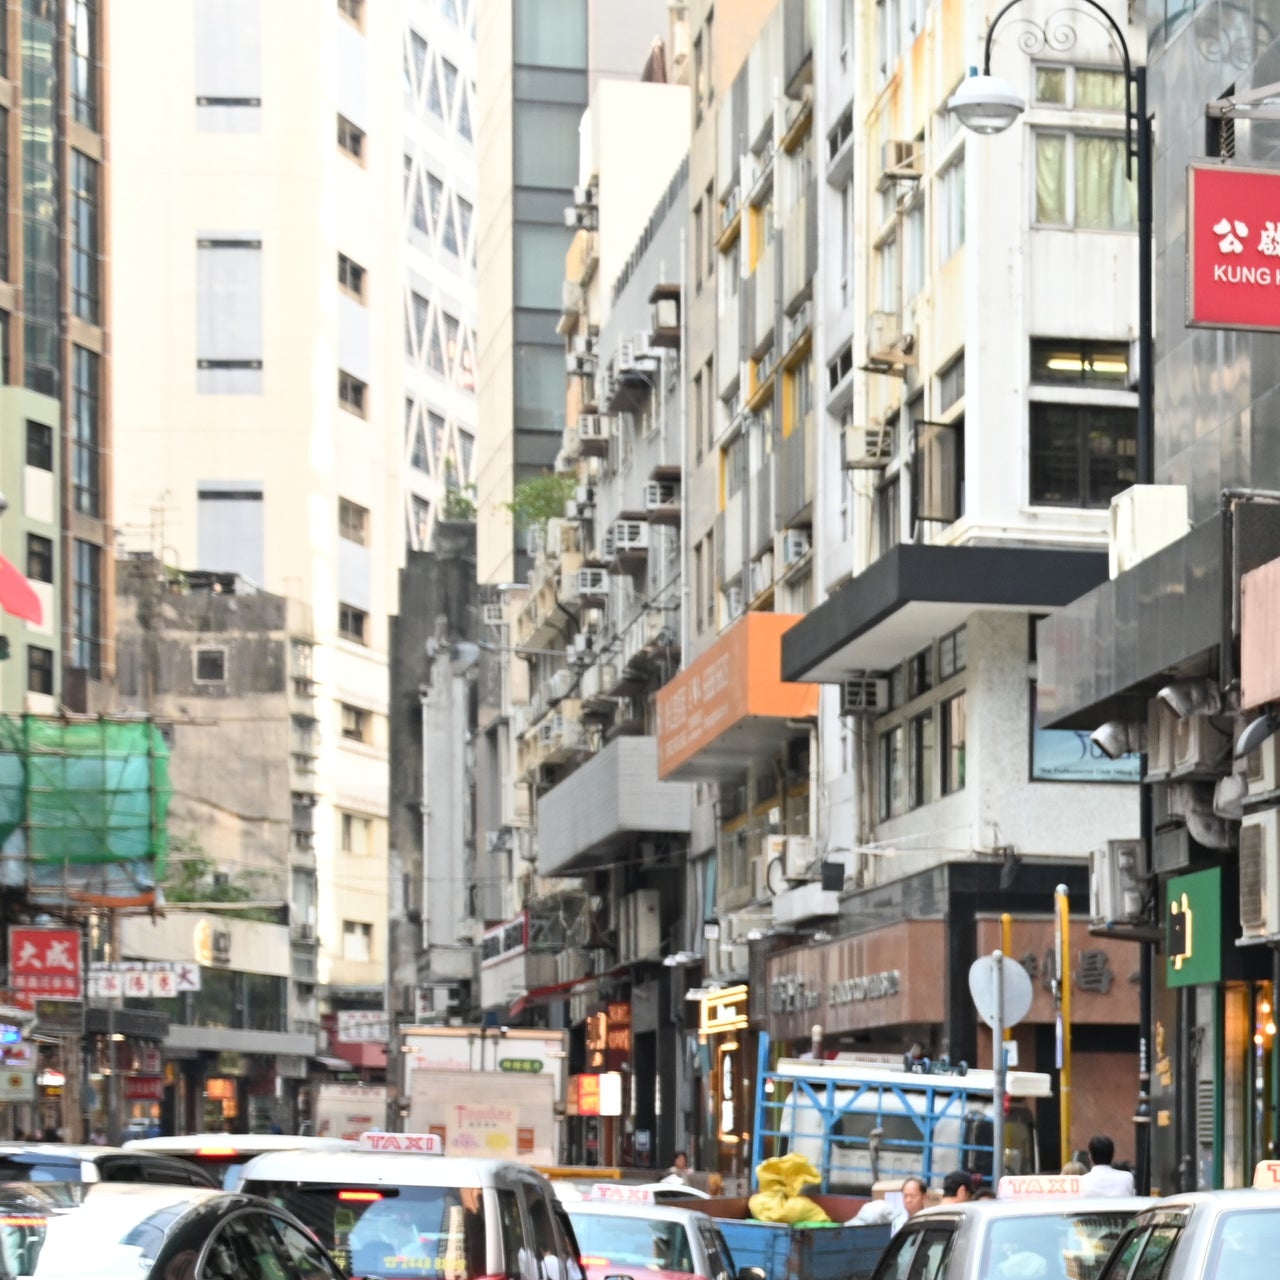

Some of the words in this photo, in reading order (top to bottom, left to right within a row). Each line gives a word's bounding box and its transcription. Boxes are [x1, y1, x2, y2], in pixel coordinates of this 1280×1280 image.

[1213, 263, 1271, 286] KUNG
[367, 1135, 434, 1151] TAXI
[1008, 1178, 1081, 1195] TAXI
